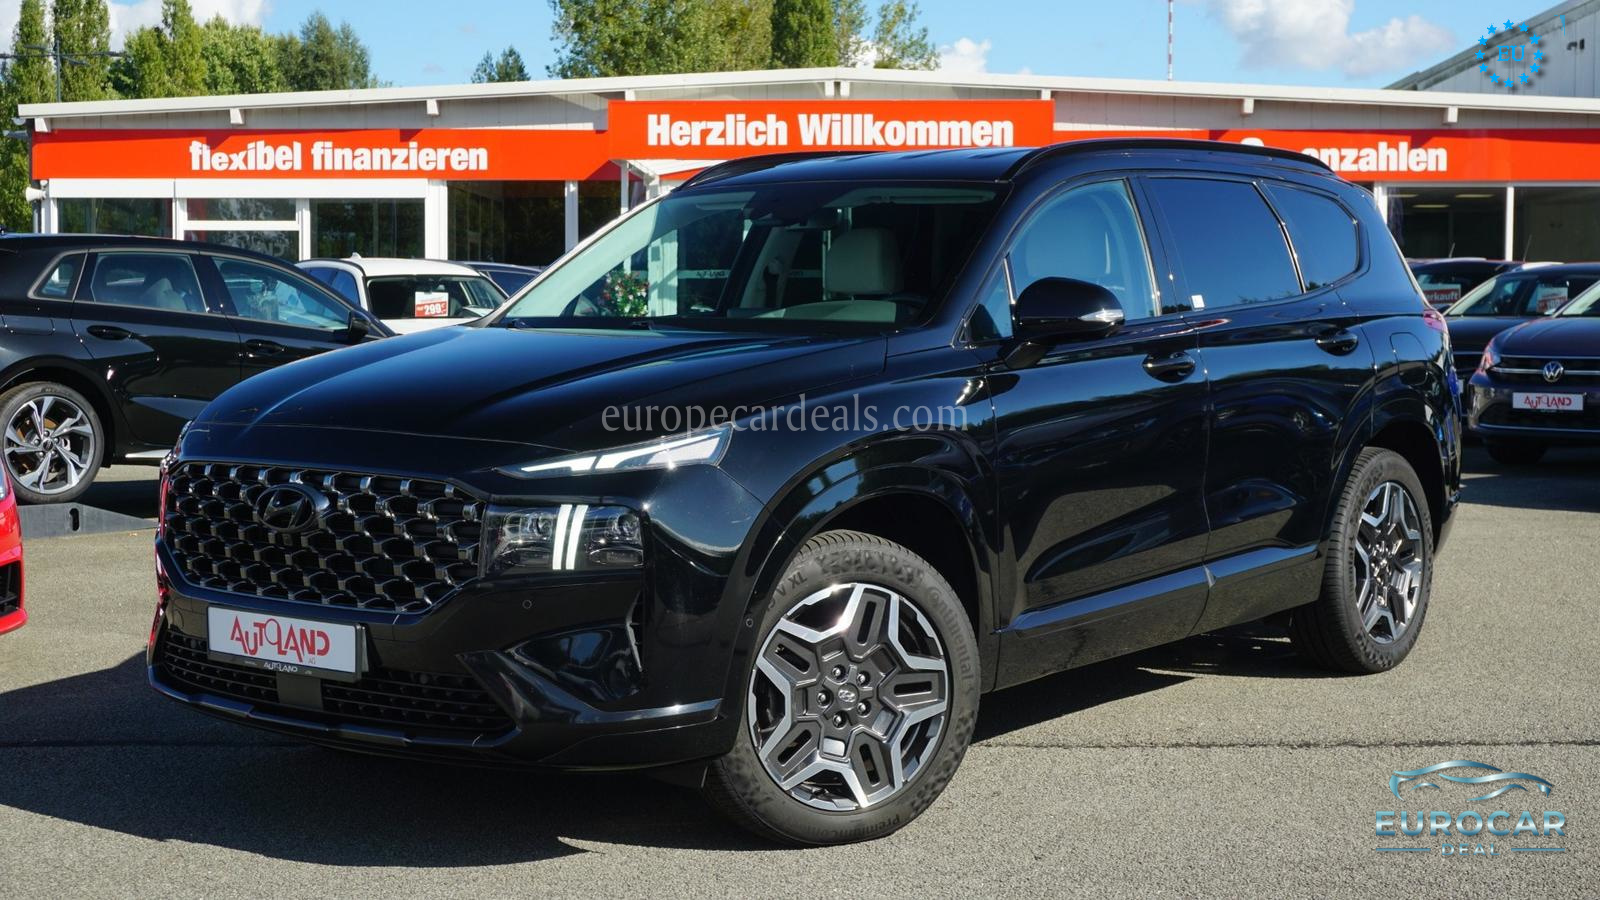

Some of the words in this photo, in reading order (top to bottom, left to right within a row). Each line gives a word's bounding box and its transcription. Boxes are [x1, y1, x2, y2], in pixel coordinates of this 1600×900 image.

[647, 113, 788, 146] Herzlich
[798, 113, 1014, 146] Willkommen
[189, 140, 302, 171] flexibel
[311, 141, 488, 171] finanzieren
[1426, 291, 1459, 301] erkauft
[1524, 395, 1572, 409] AUTOLAND
[230, 616, 330, 662] AUTOLAND
[264, 661, 298, 673] AUTOLAND
